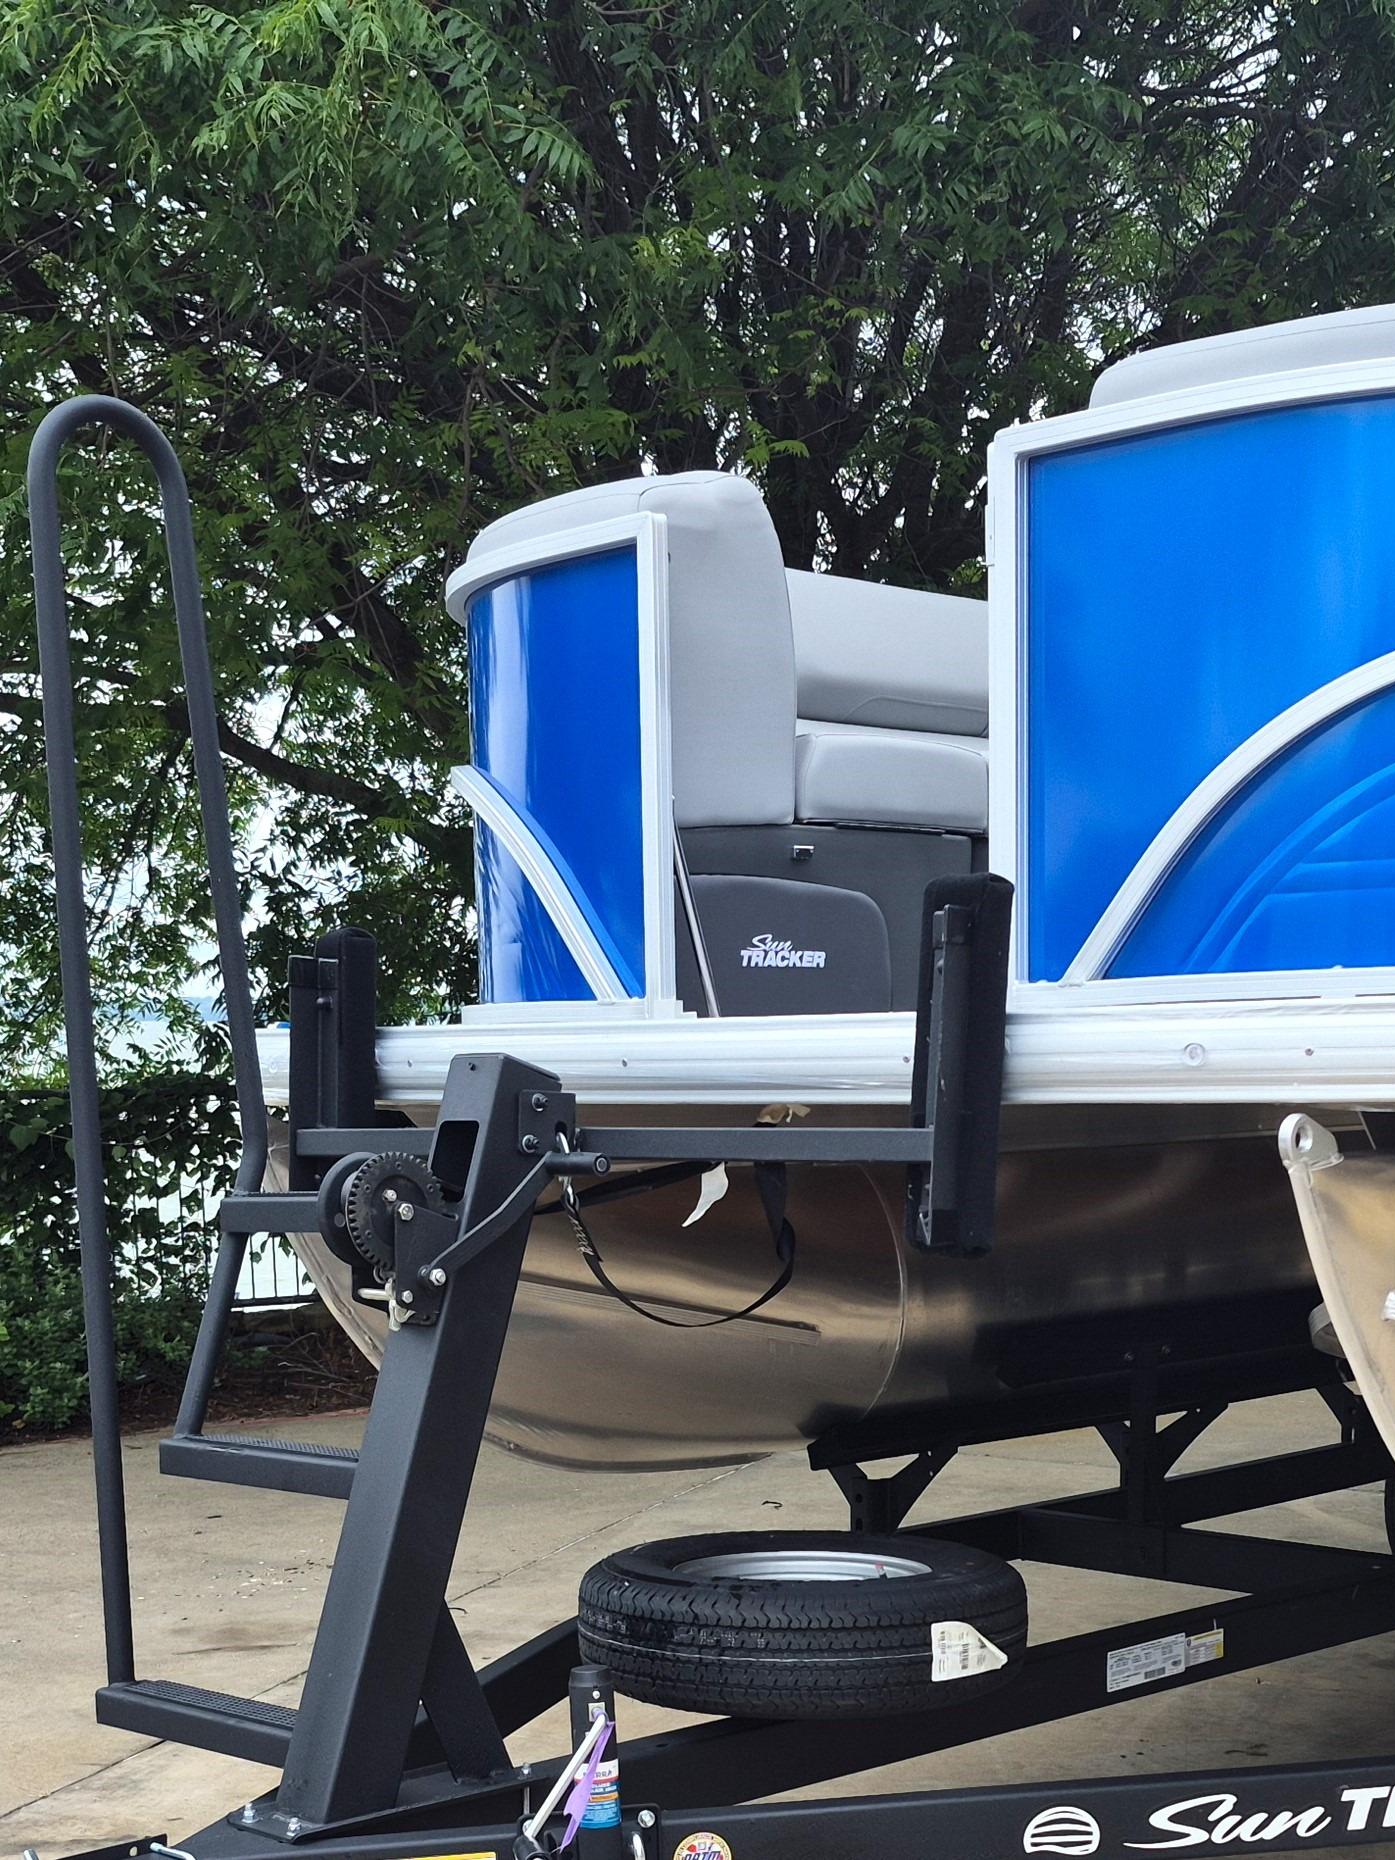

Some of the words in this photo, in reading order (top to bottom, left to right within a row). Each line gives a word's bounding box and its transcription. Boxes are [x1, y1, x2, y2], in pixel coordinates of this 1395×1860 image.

[746, 933, 793, 952] Sun
[740, 949, 826, 968] TRACKER
[1122, 1792, 1333, 1849] Sun
